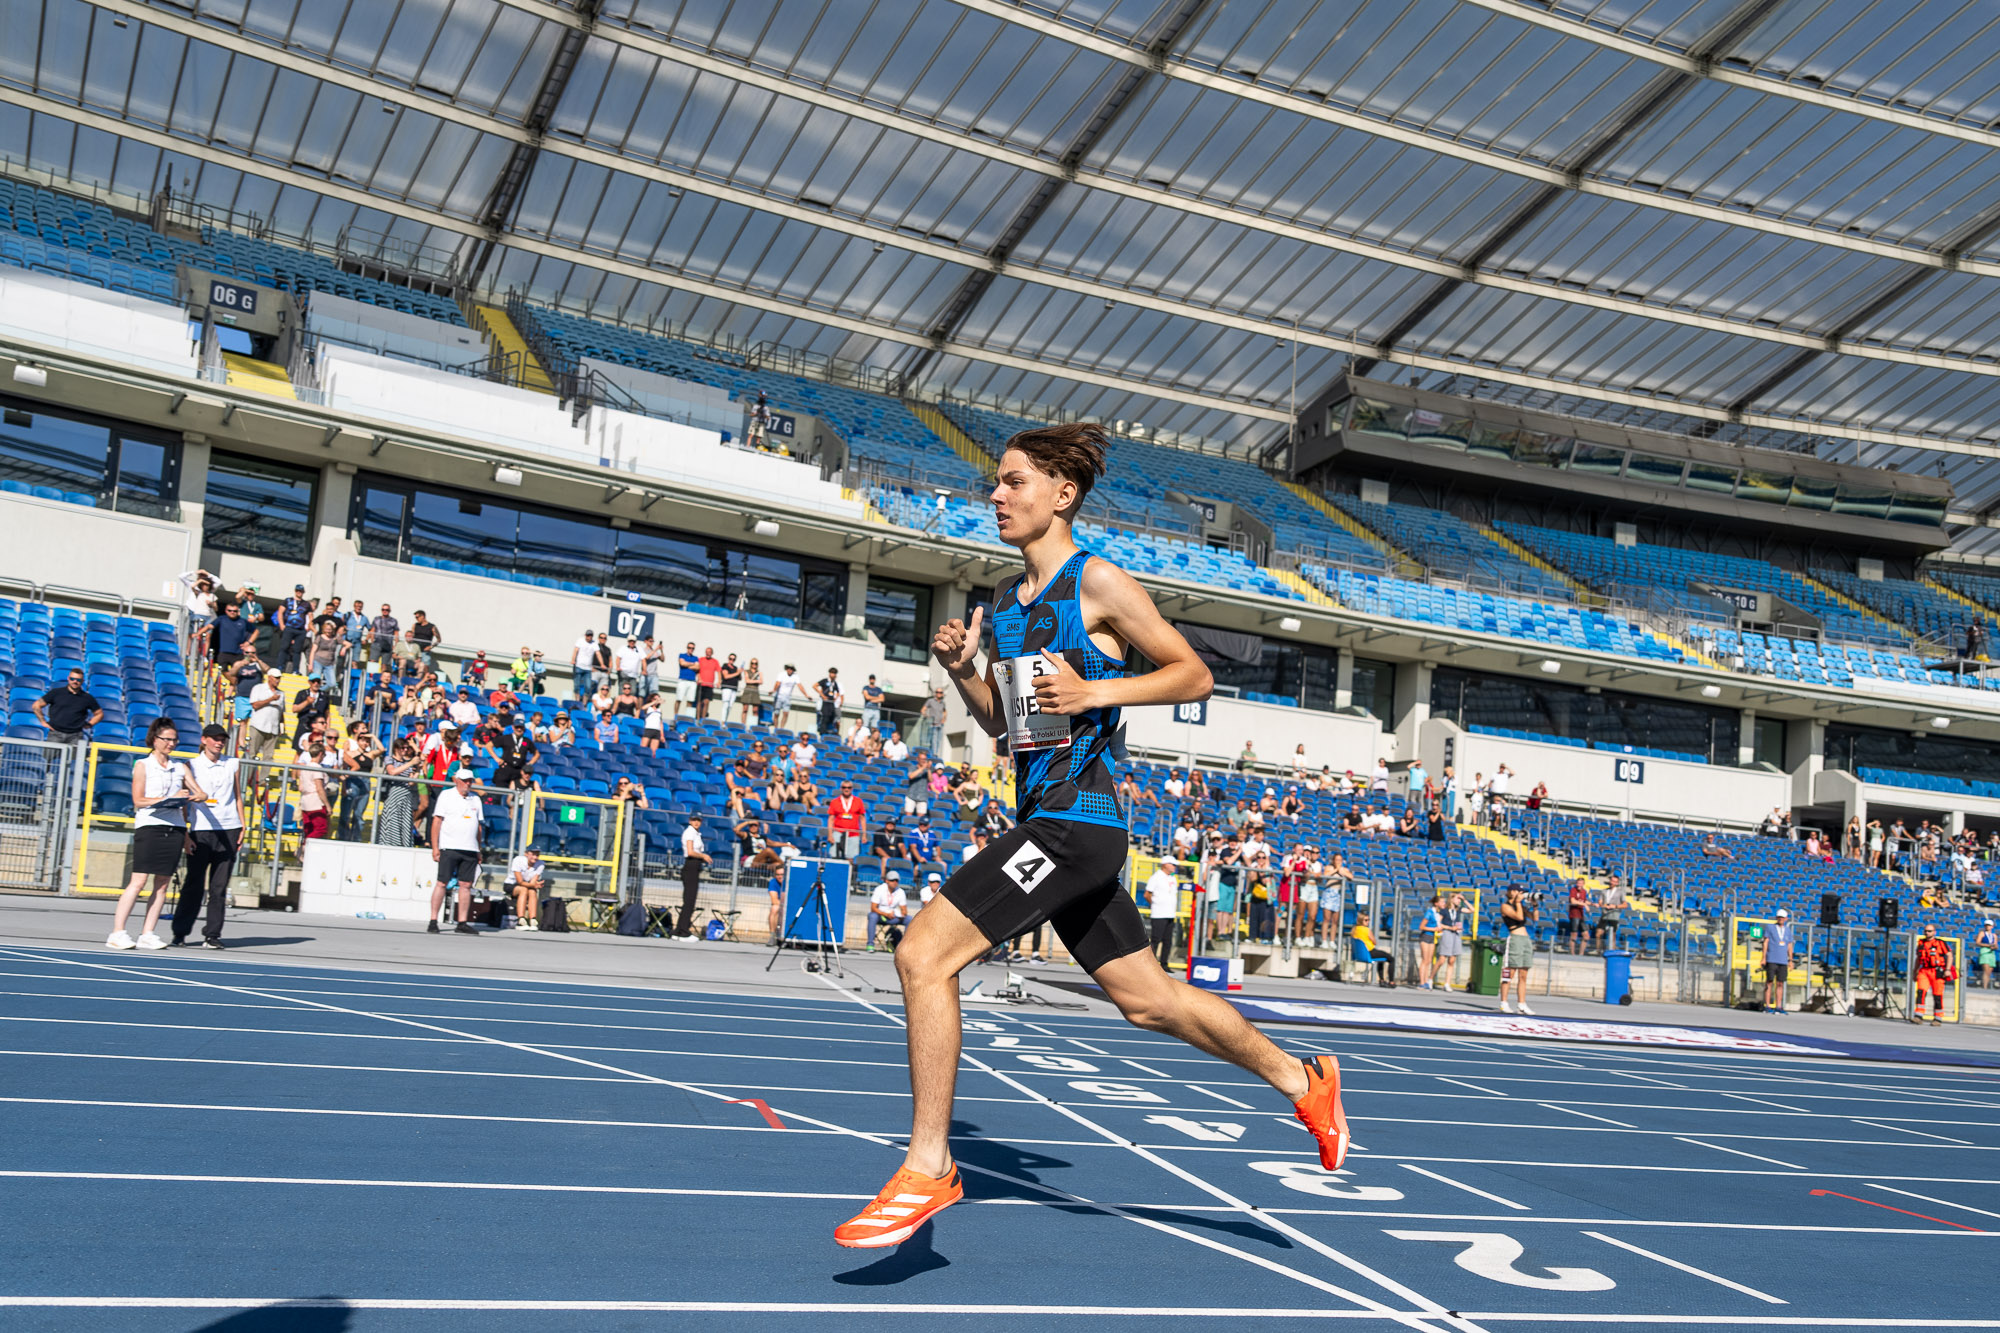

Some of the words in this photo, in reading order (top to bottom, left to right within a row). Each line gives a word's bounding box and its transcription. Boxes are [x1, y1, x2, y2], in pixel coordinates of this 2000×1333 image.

[213, 285, 237, 305] 06
[242, 295, 253, 310] G
[783, 421, 792, 434] G
[1205, 508, 1214, 520] G
[617, 611, 647, 636] 07
[1006, 623, 1020, 632] SMS
[1032, 660, 1044, 677] 5
[1179, 702, 1201, 721] 08
[1037, 730, 1056, 739] Polski
[1057, 729, 1070, 737] U18
[1619, 762, 1640, 781] 09
[568, 808, 577, 821] 8
[1014, 857, 1047, 885] 4
[988, 1036, 1055, 1050] 7
[1067, 1081, 1171, 1103] 5
[1142, 1115, 1247, 1142] 4
[1248, 1161, 1405, 1201] 3
[1380, 1229, 1617, 1292] 2
